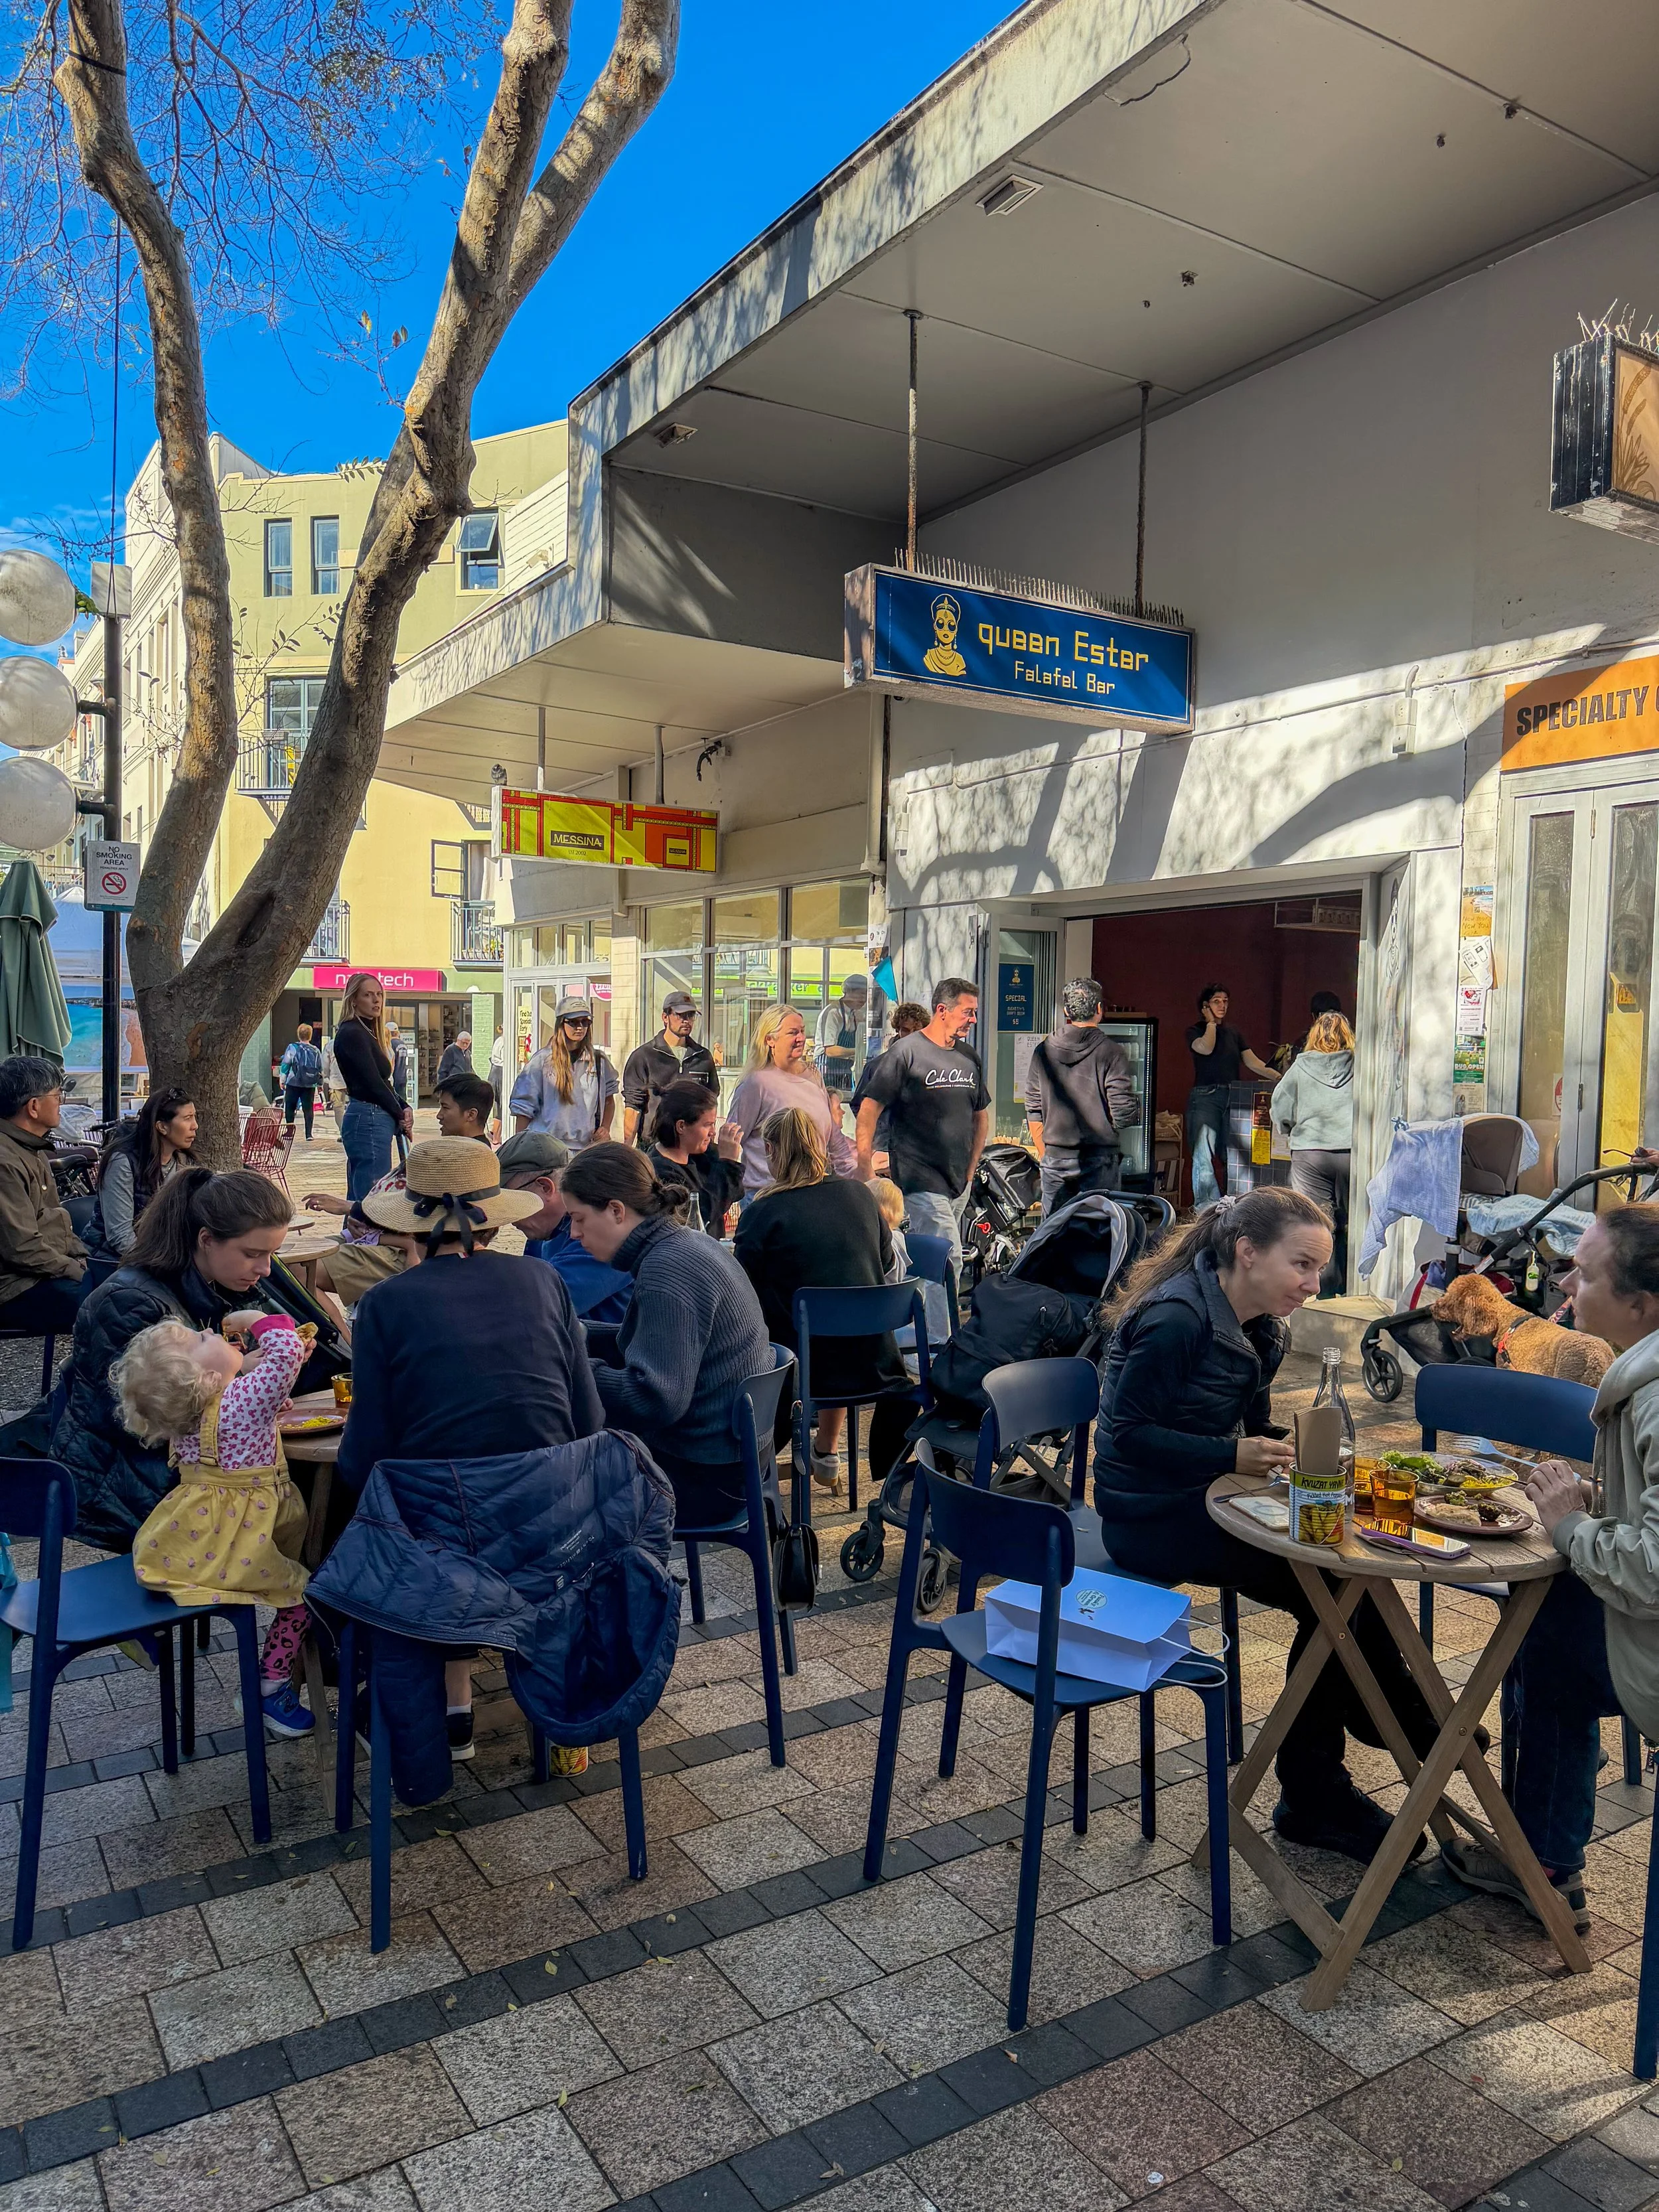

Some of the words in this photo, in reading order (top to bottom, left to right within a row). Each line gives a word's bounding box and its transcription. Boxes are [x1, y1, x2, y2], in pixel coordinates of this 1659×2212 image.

[979, 623, 1060, 656] queen
[1074, 630, 1149, 671] Ester
[1015, 660, 1078, 690] Falafel
[1087, 672, 1116, 695] Bar
[1516, 685, 1650, 737] SPECIALTY
[553, 834, 602, 847] MESSINA
[96, 851, 132, 860] SMOKING
[1301, 1477, 1328, 1489] KVUZAT
